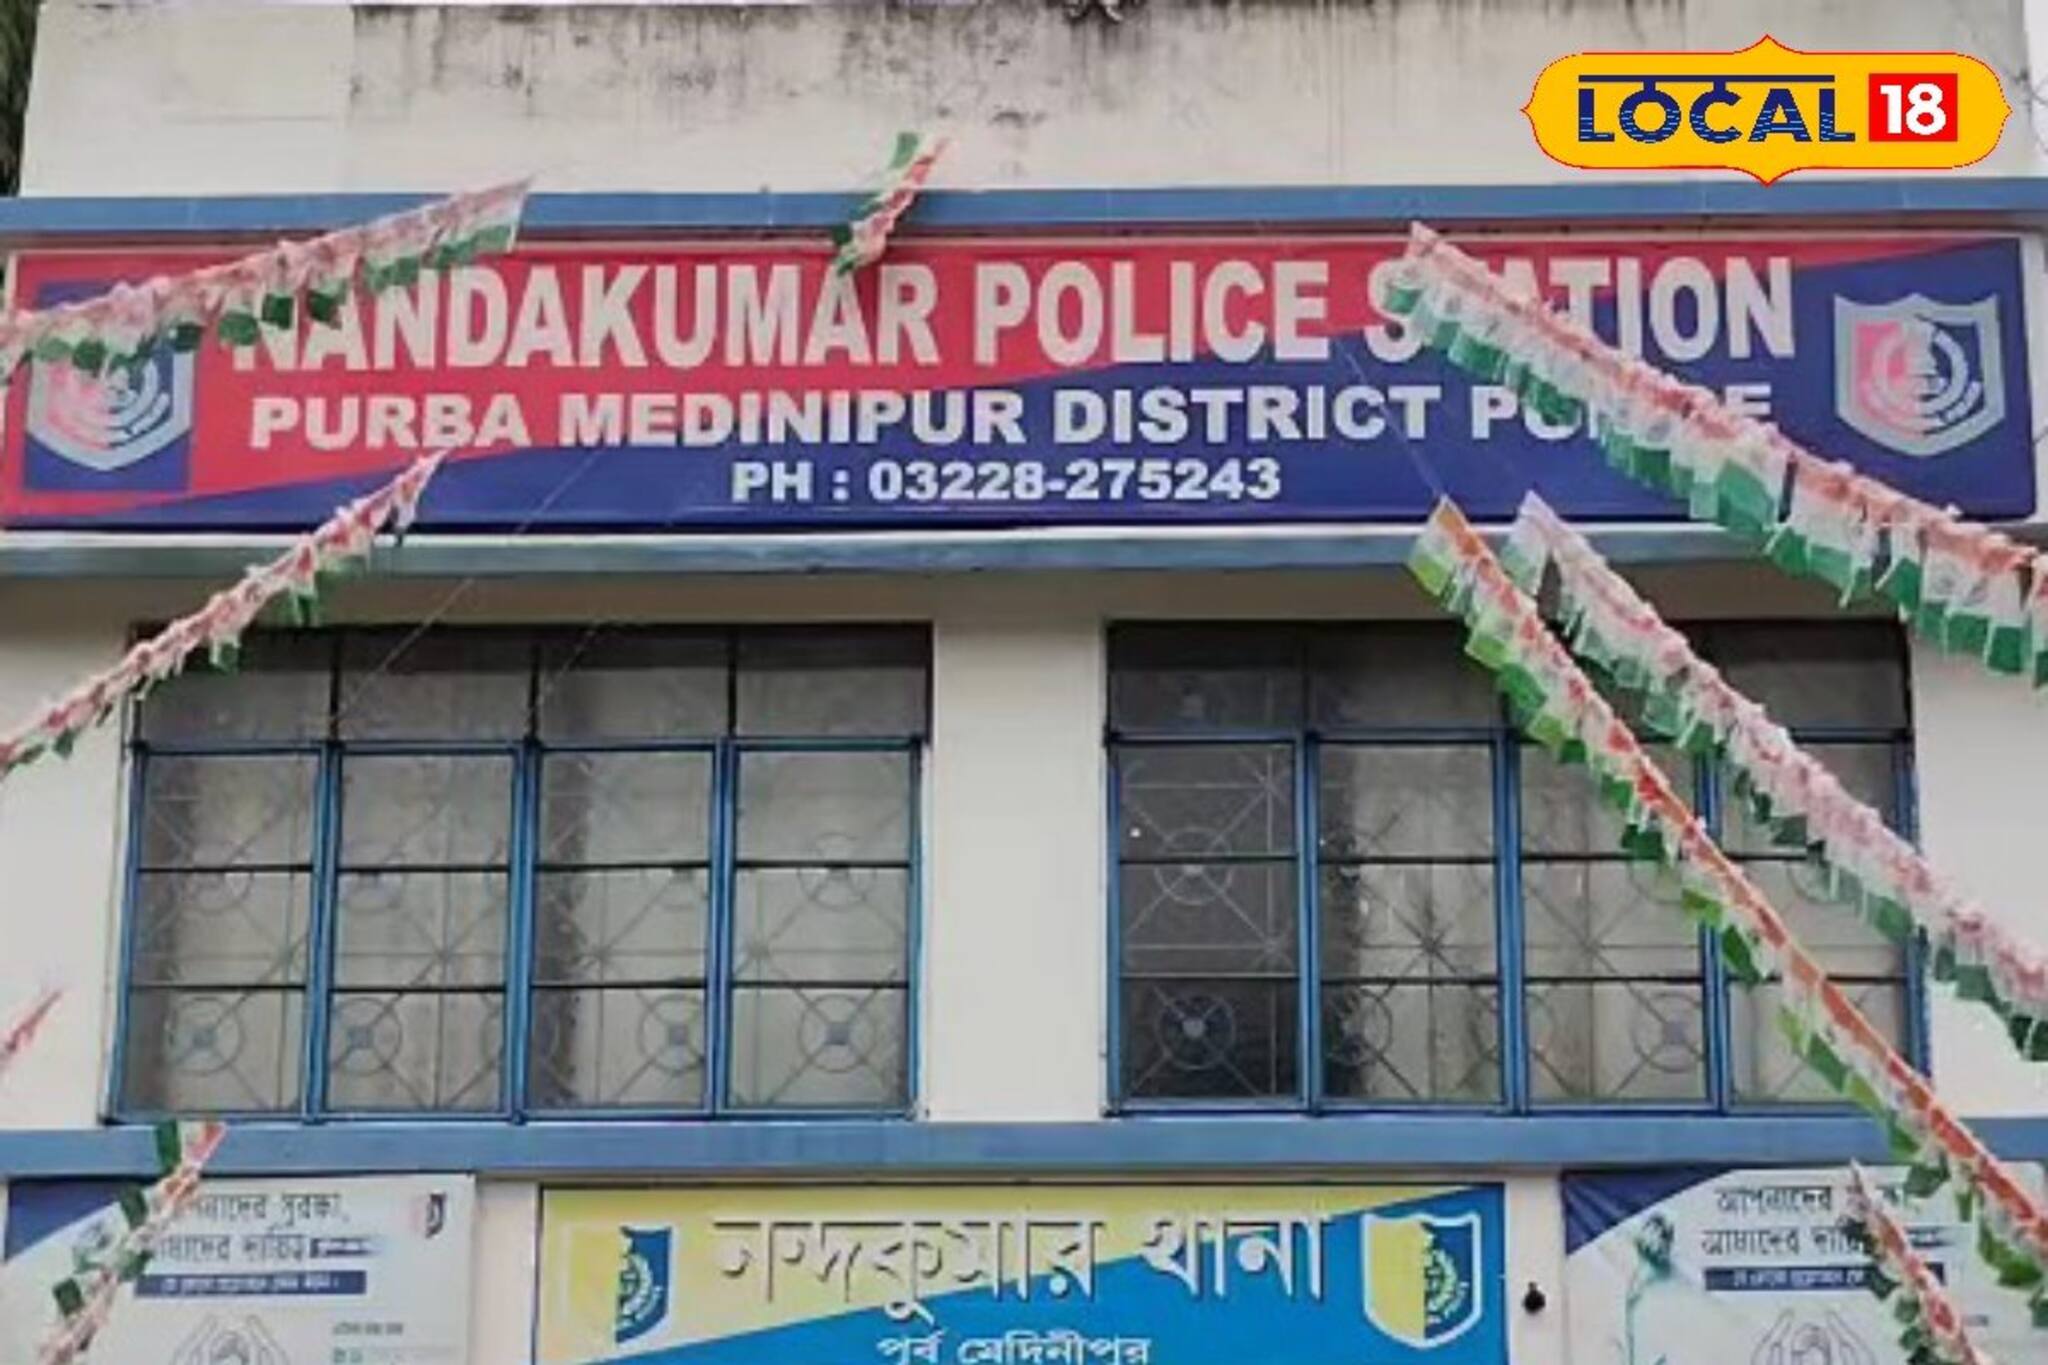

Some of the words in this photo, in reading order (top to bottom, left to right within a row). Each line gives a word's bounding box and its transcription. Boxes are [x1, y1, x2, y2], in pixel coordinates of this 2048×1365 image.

[973, 260, 1330, 364] POLICE
[249, 393, 532, 449] PURBA
[558, 389, 1027, 448] MEDINIPUR
[1053, 384, 1442, 445] DISTRICT
[731, 459, 814, 502] PH
[868, 457, 1281, 501] 03228-275243
[708, 1212, 1104, 1329] নন্দকুমার
[1140, 1212, 1333, 1302] থানা
